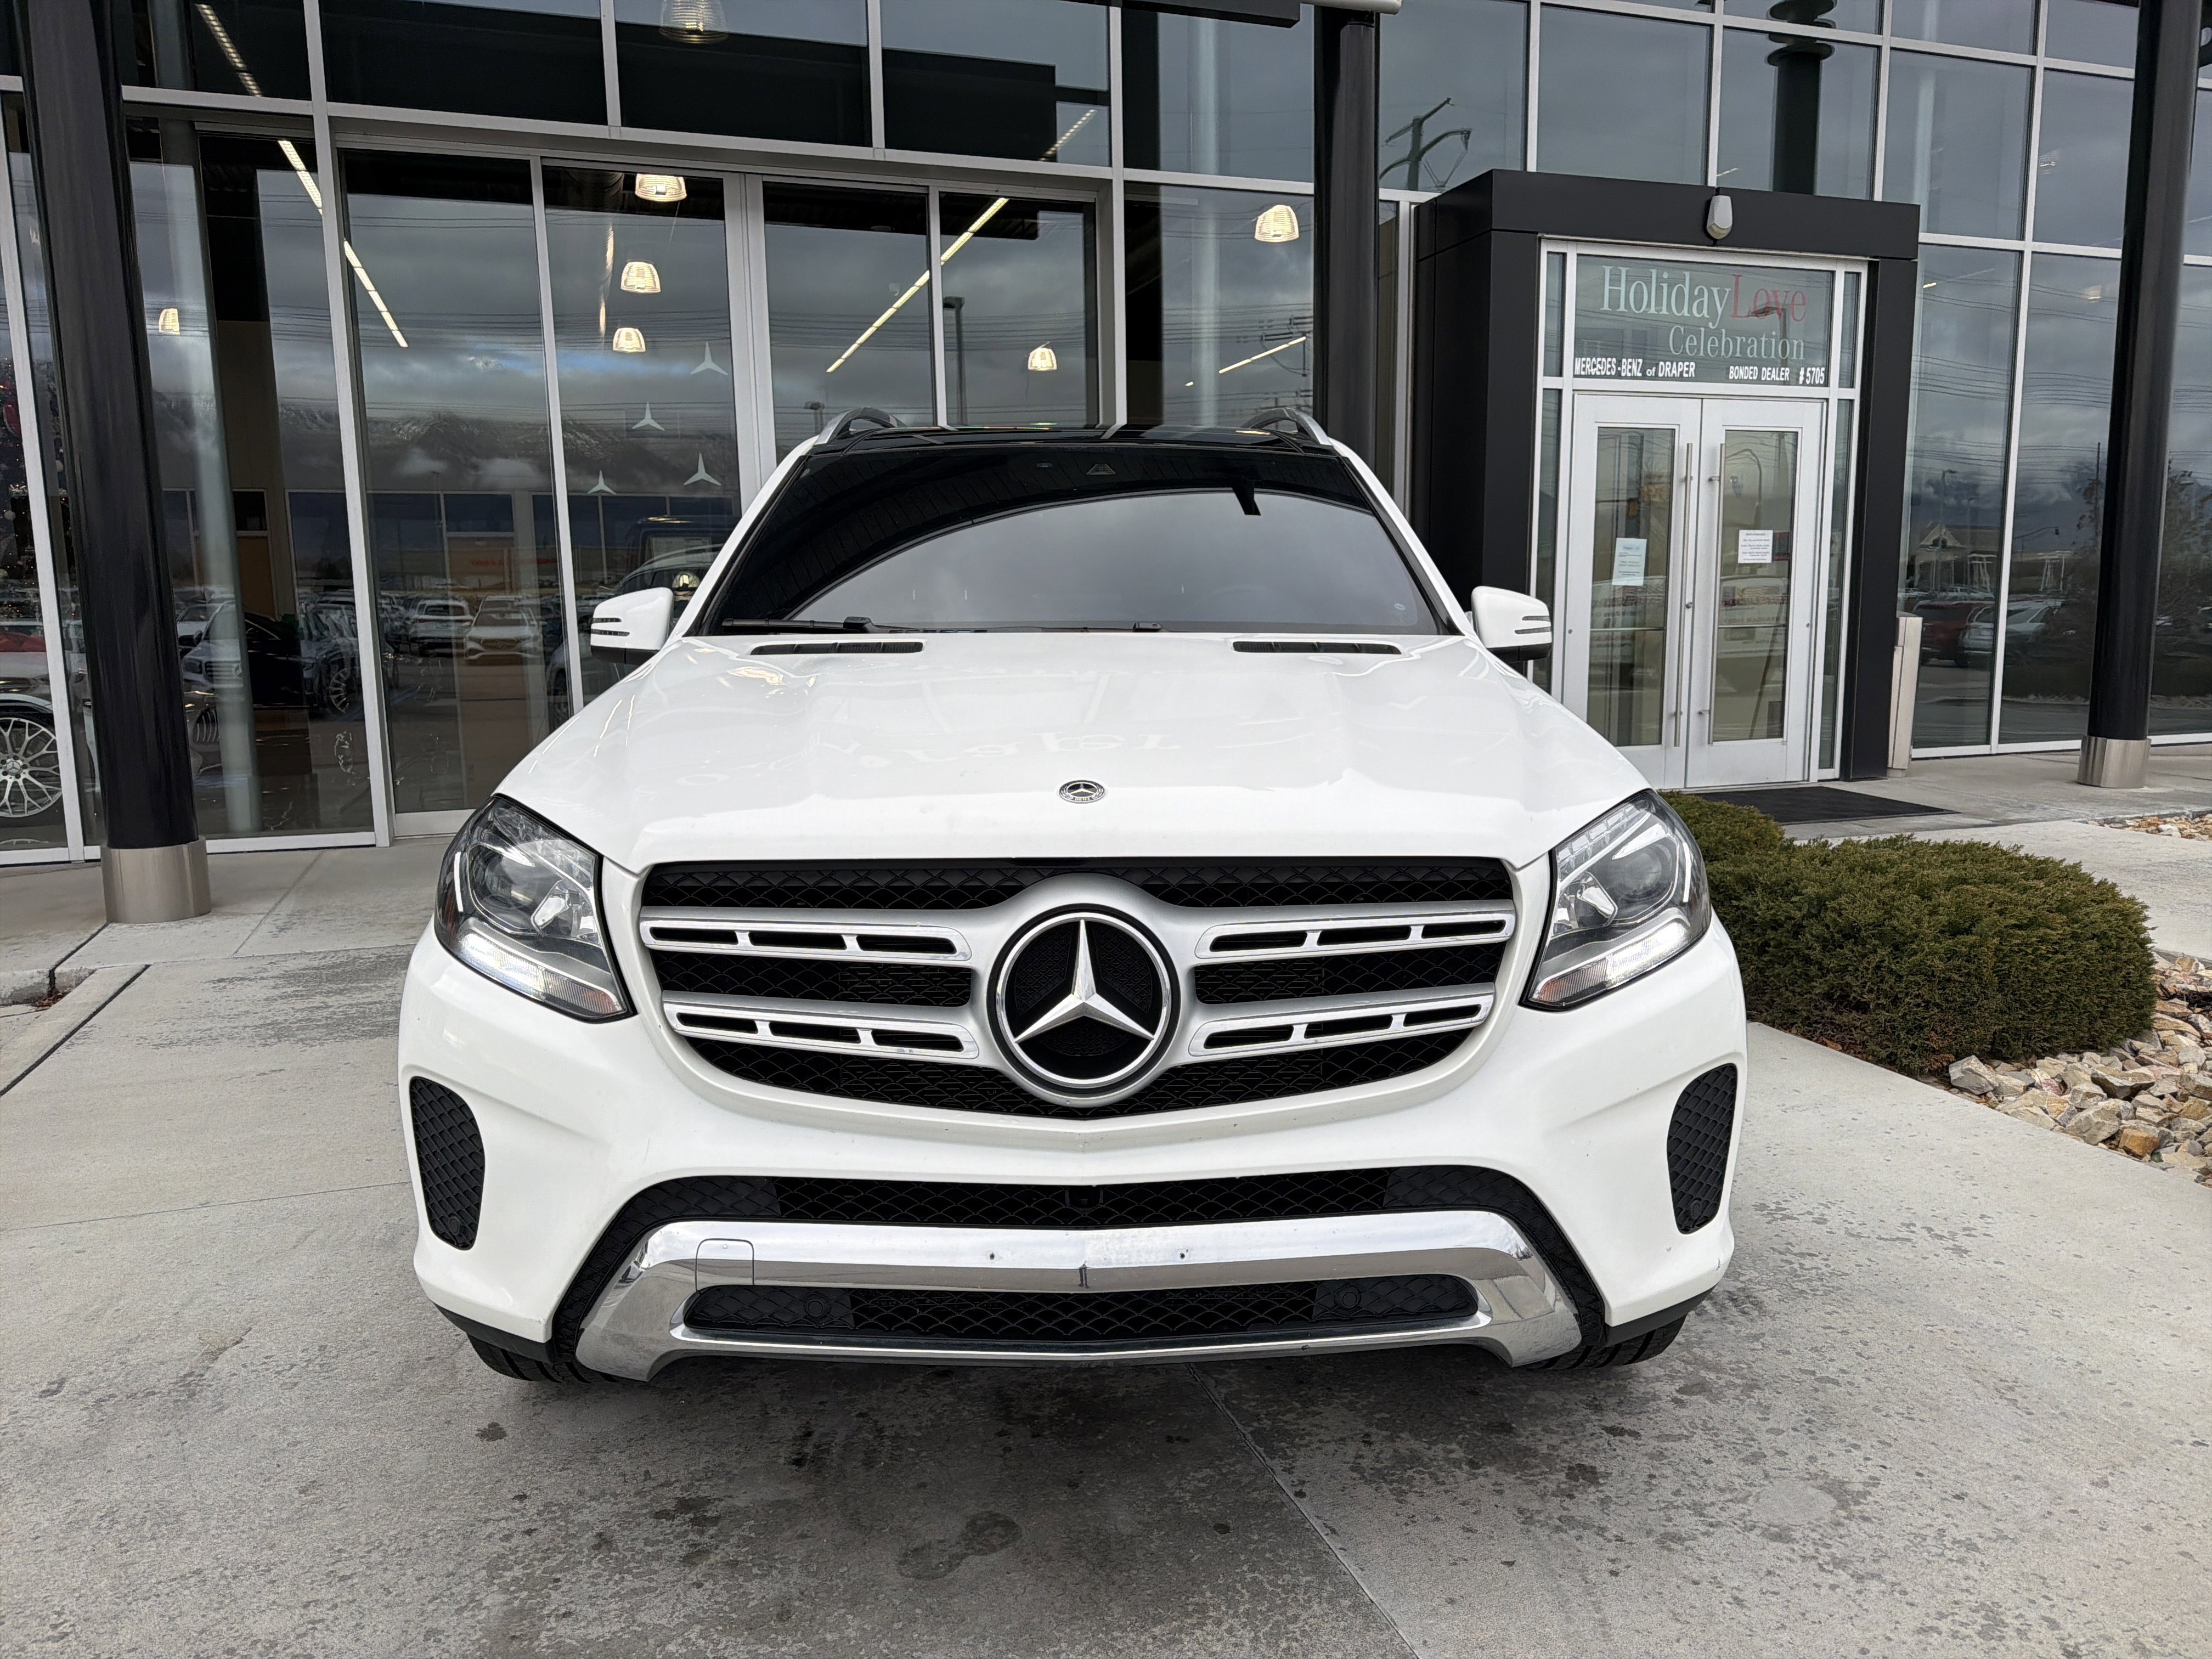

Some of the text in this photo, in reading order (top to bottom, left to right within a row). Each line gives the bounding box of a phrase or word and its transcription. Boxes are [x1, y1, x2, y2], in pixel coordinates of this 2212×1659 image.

[1669, 325, 1805, 360] Celebration
[1646, 367, 1656, 376] of
[1658, 361, 1696, 377] DRAPER
[1729, 365, 1758, 380] BONDED
[1761, 367, 1790, 381] DEALER
